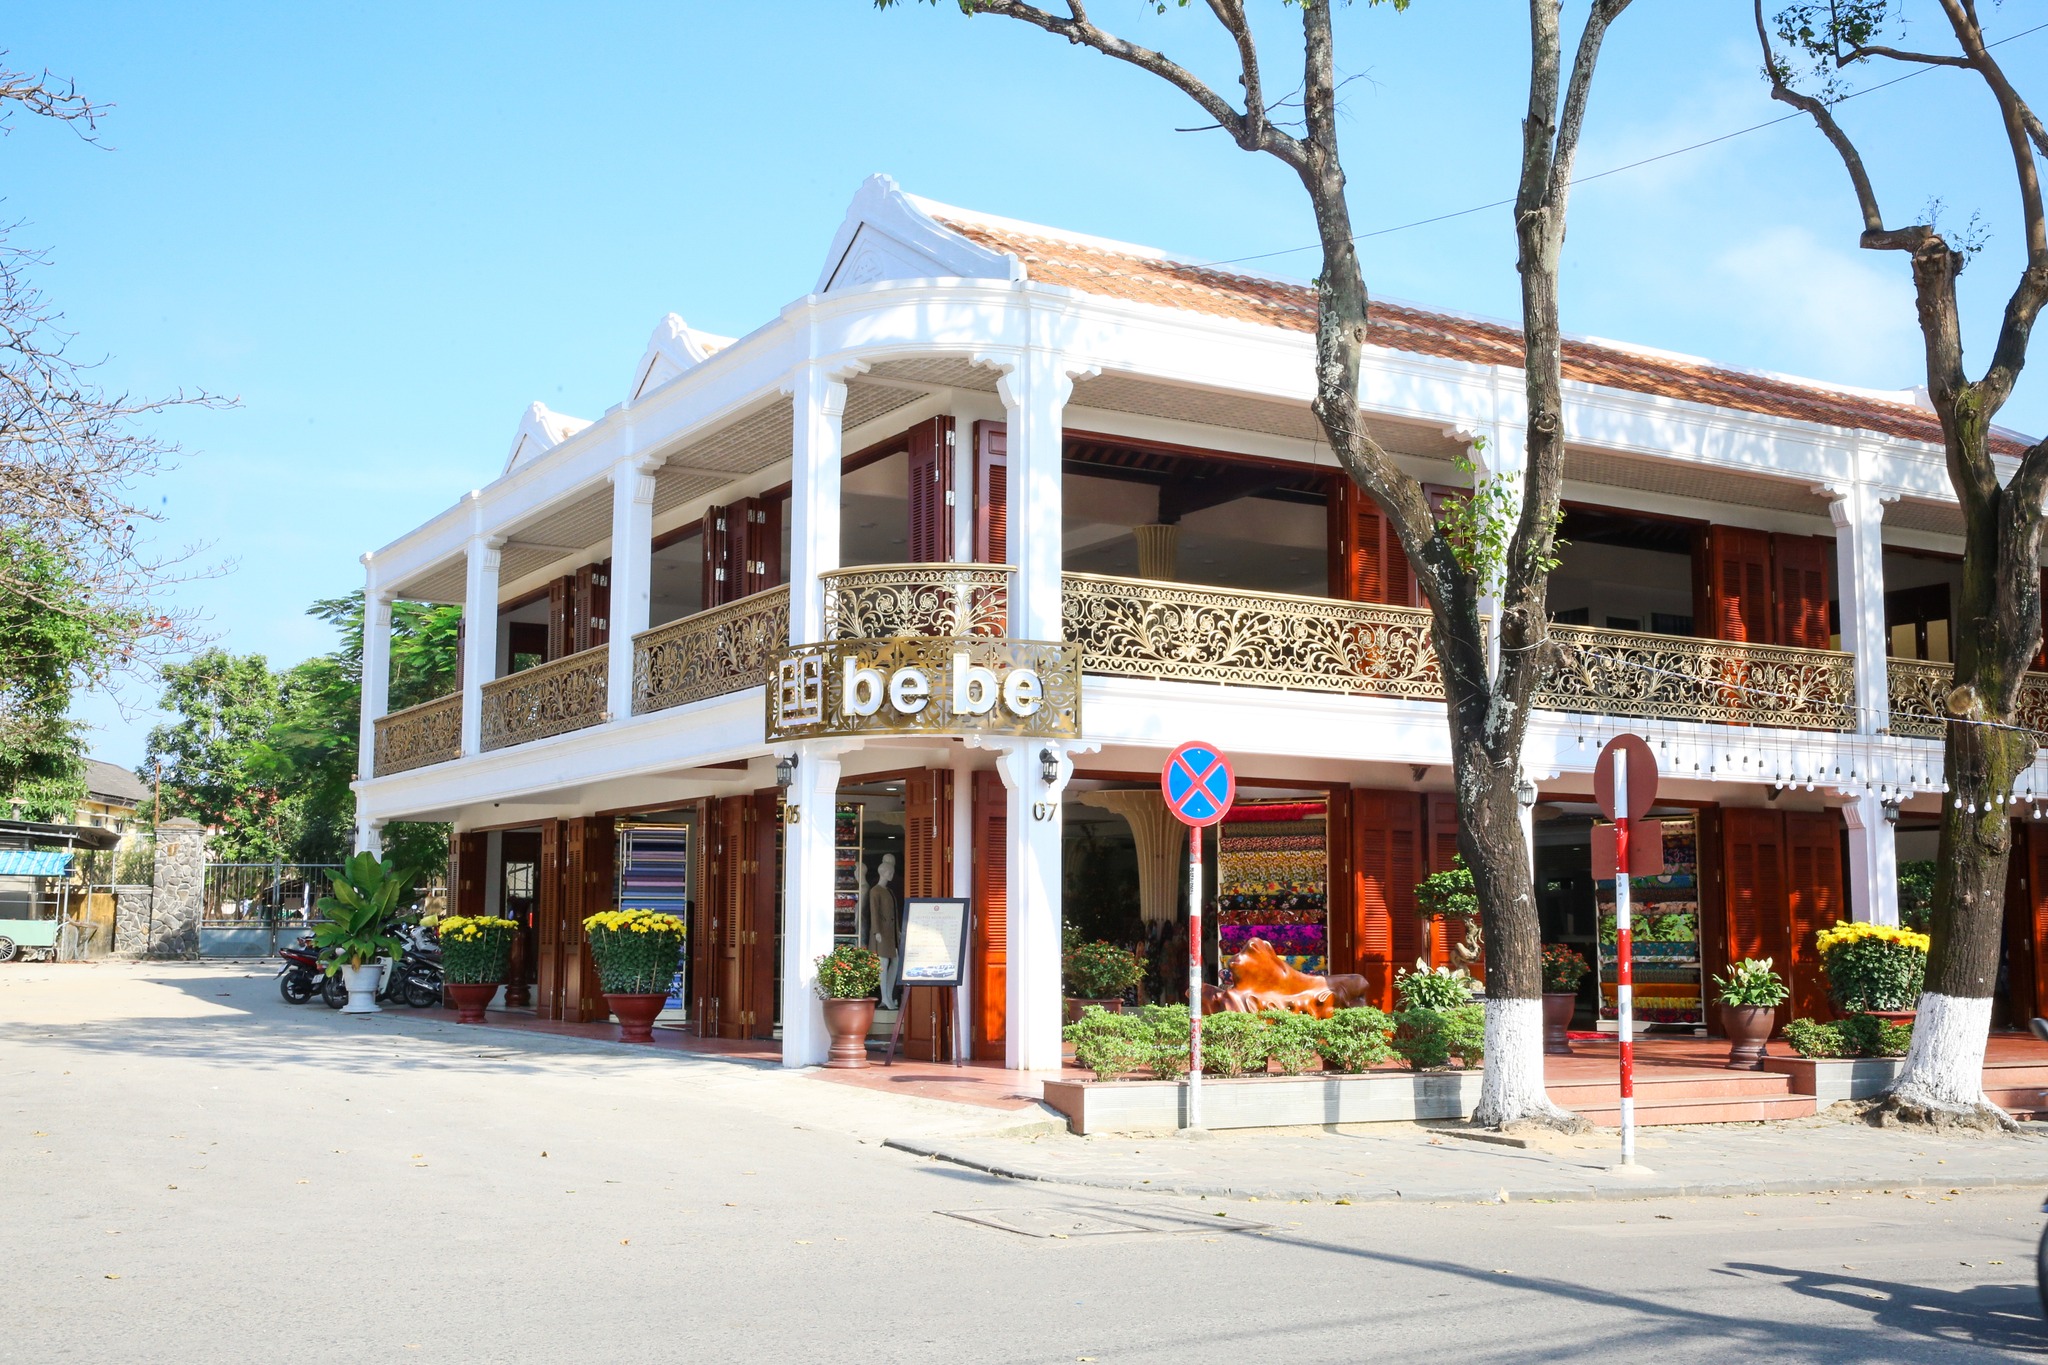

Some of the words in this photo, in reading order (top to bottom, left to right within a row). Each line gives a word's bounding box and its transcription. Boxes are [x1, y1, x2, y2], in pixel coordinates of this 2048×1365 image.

[842, 655, 931, 717] be
[952, 653, 1045, 718] be
[1032, 801, 1058, 822] 07
